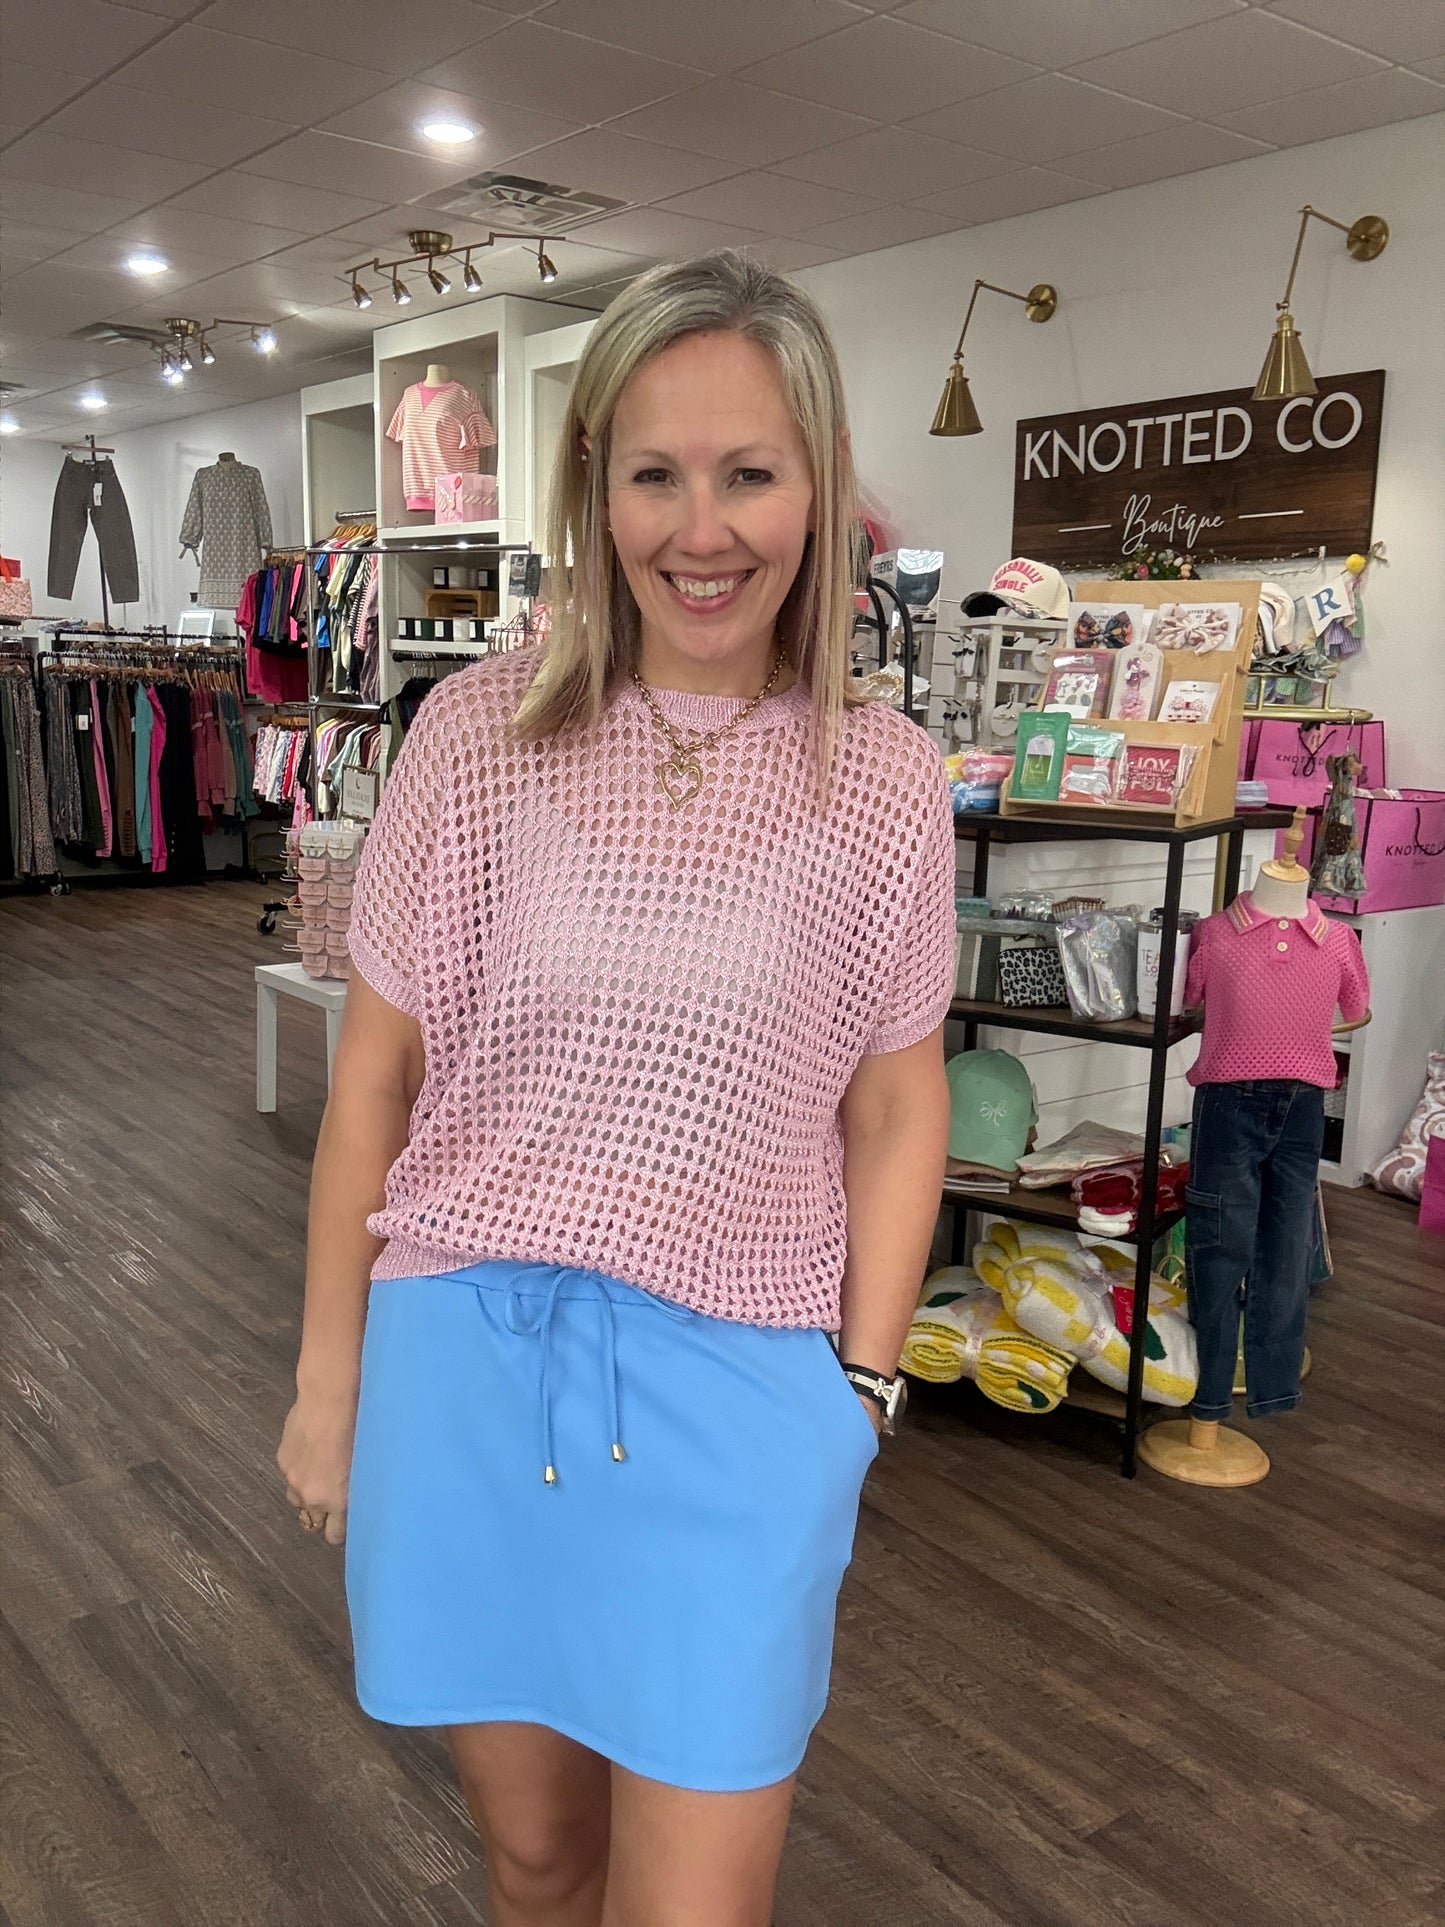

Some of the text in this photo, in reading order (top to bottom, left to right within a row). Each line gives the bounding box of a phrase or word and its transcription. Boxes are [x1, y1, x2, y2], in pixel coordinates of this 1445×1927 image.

[1023, 391, 1363, 481] KNOTTED CO
[1121, 494, 1225, 555] Boutique
[993, 579, 1029, 594] SINGLE
[1312, 587, 1342, 621] R
[1136, 757, 1171, 773] JOY
